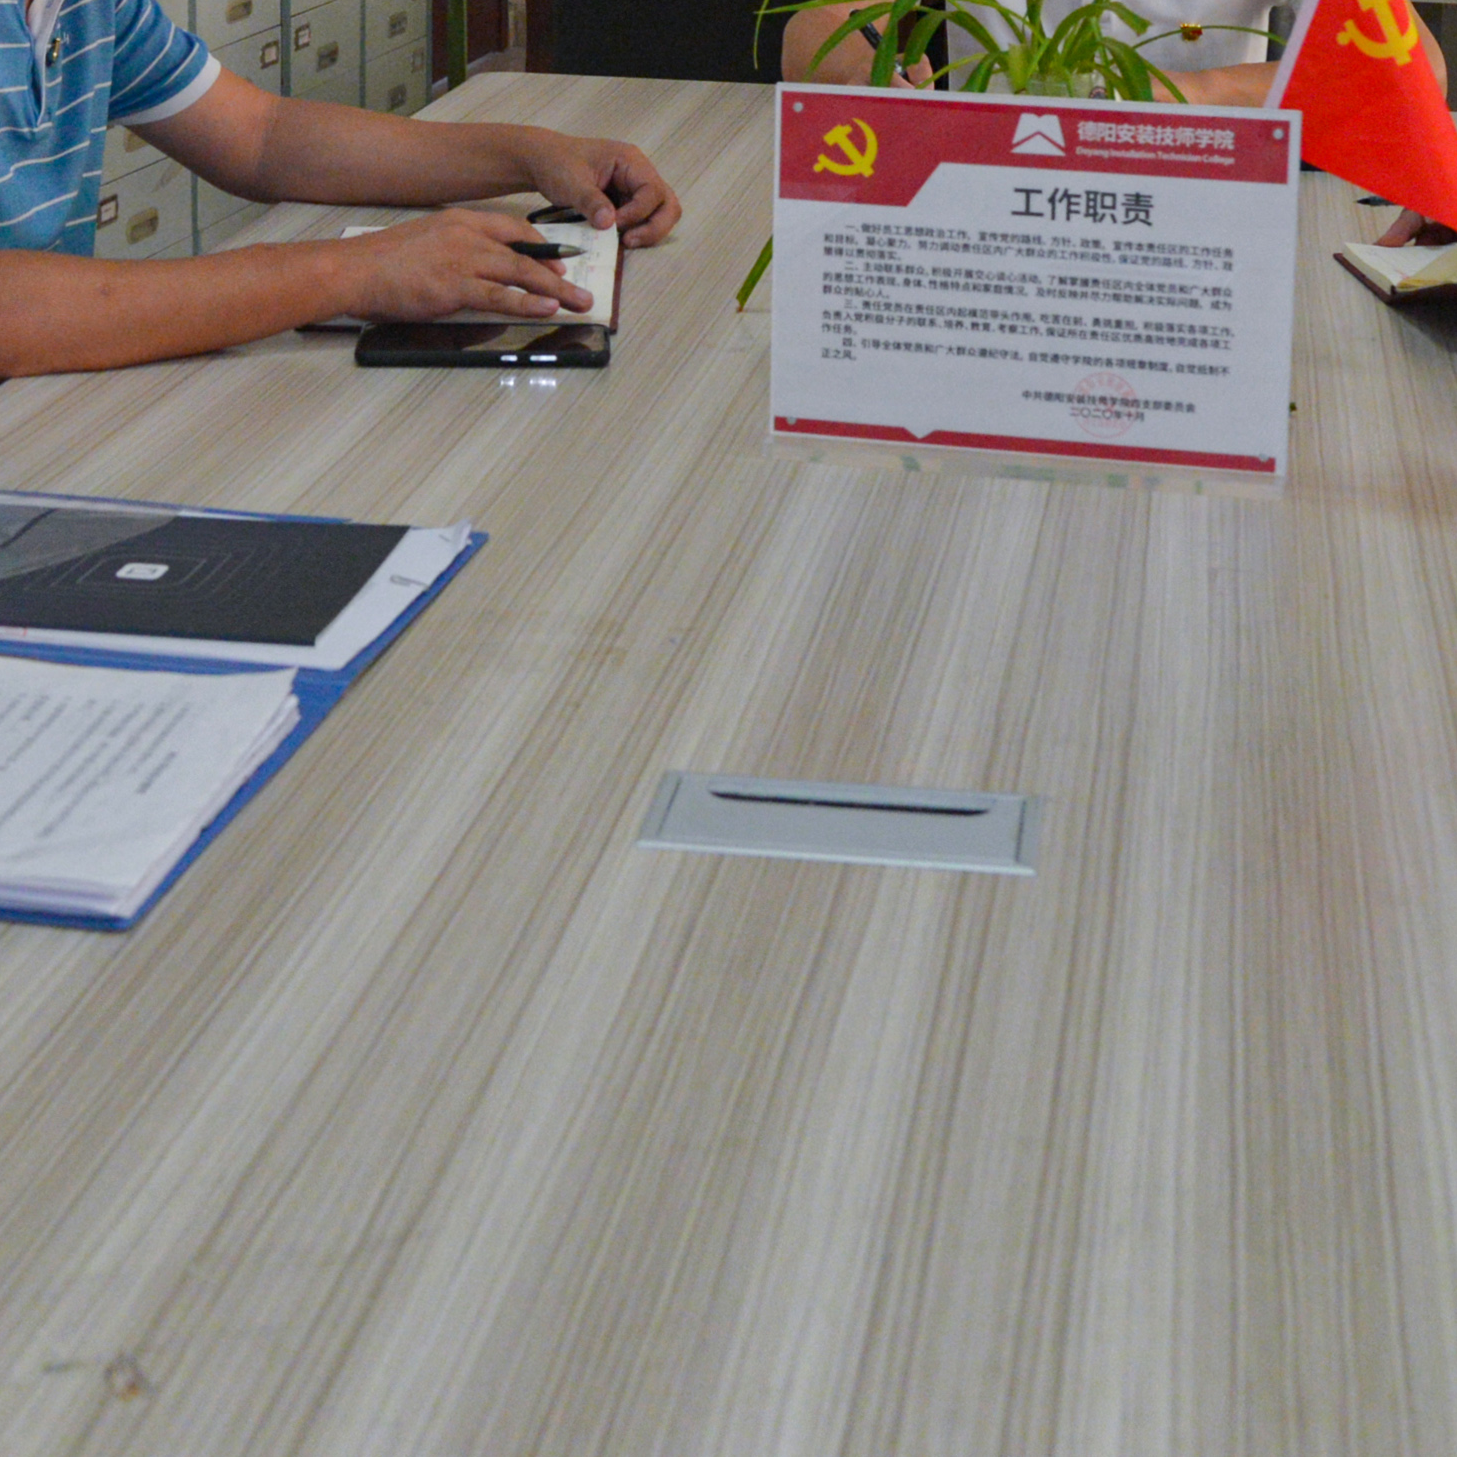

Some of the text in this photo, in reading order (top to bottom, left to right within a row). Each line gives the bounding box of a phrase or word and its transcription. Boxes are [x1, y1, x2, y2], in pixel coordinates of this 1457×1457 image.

[1077, 120, 1235, 150] 德阳安装技师学院
[1010, 186, 1154, 226] 工作职责
